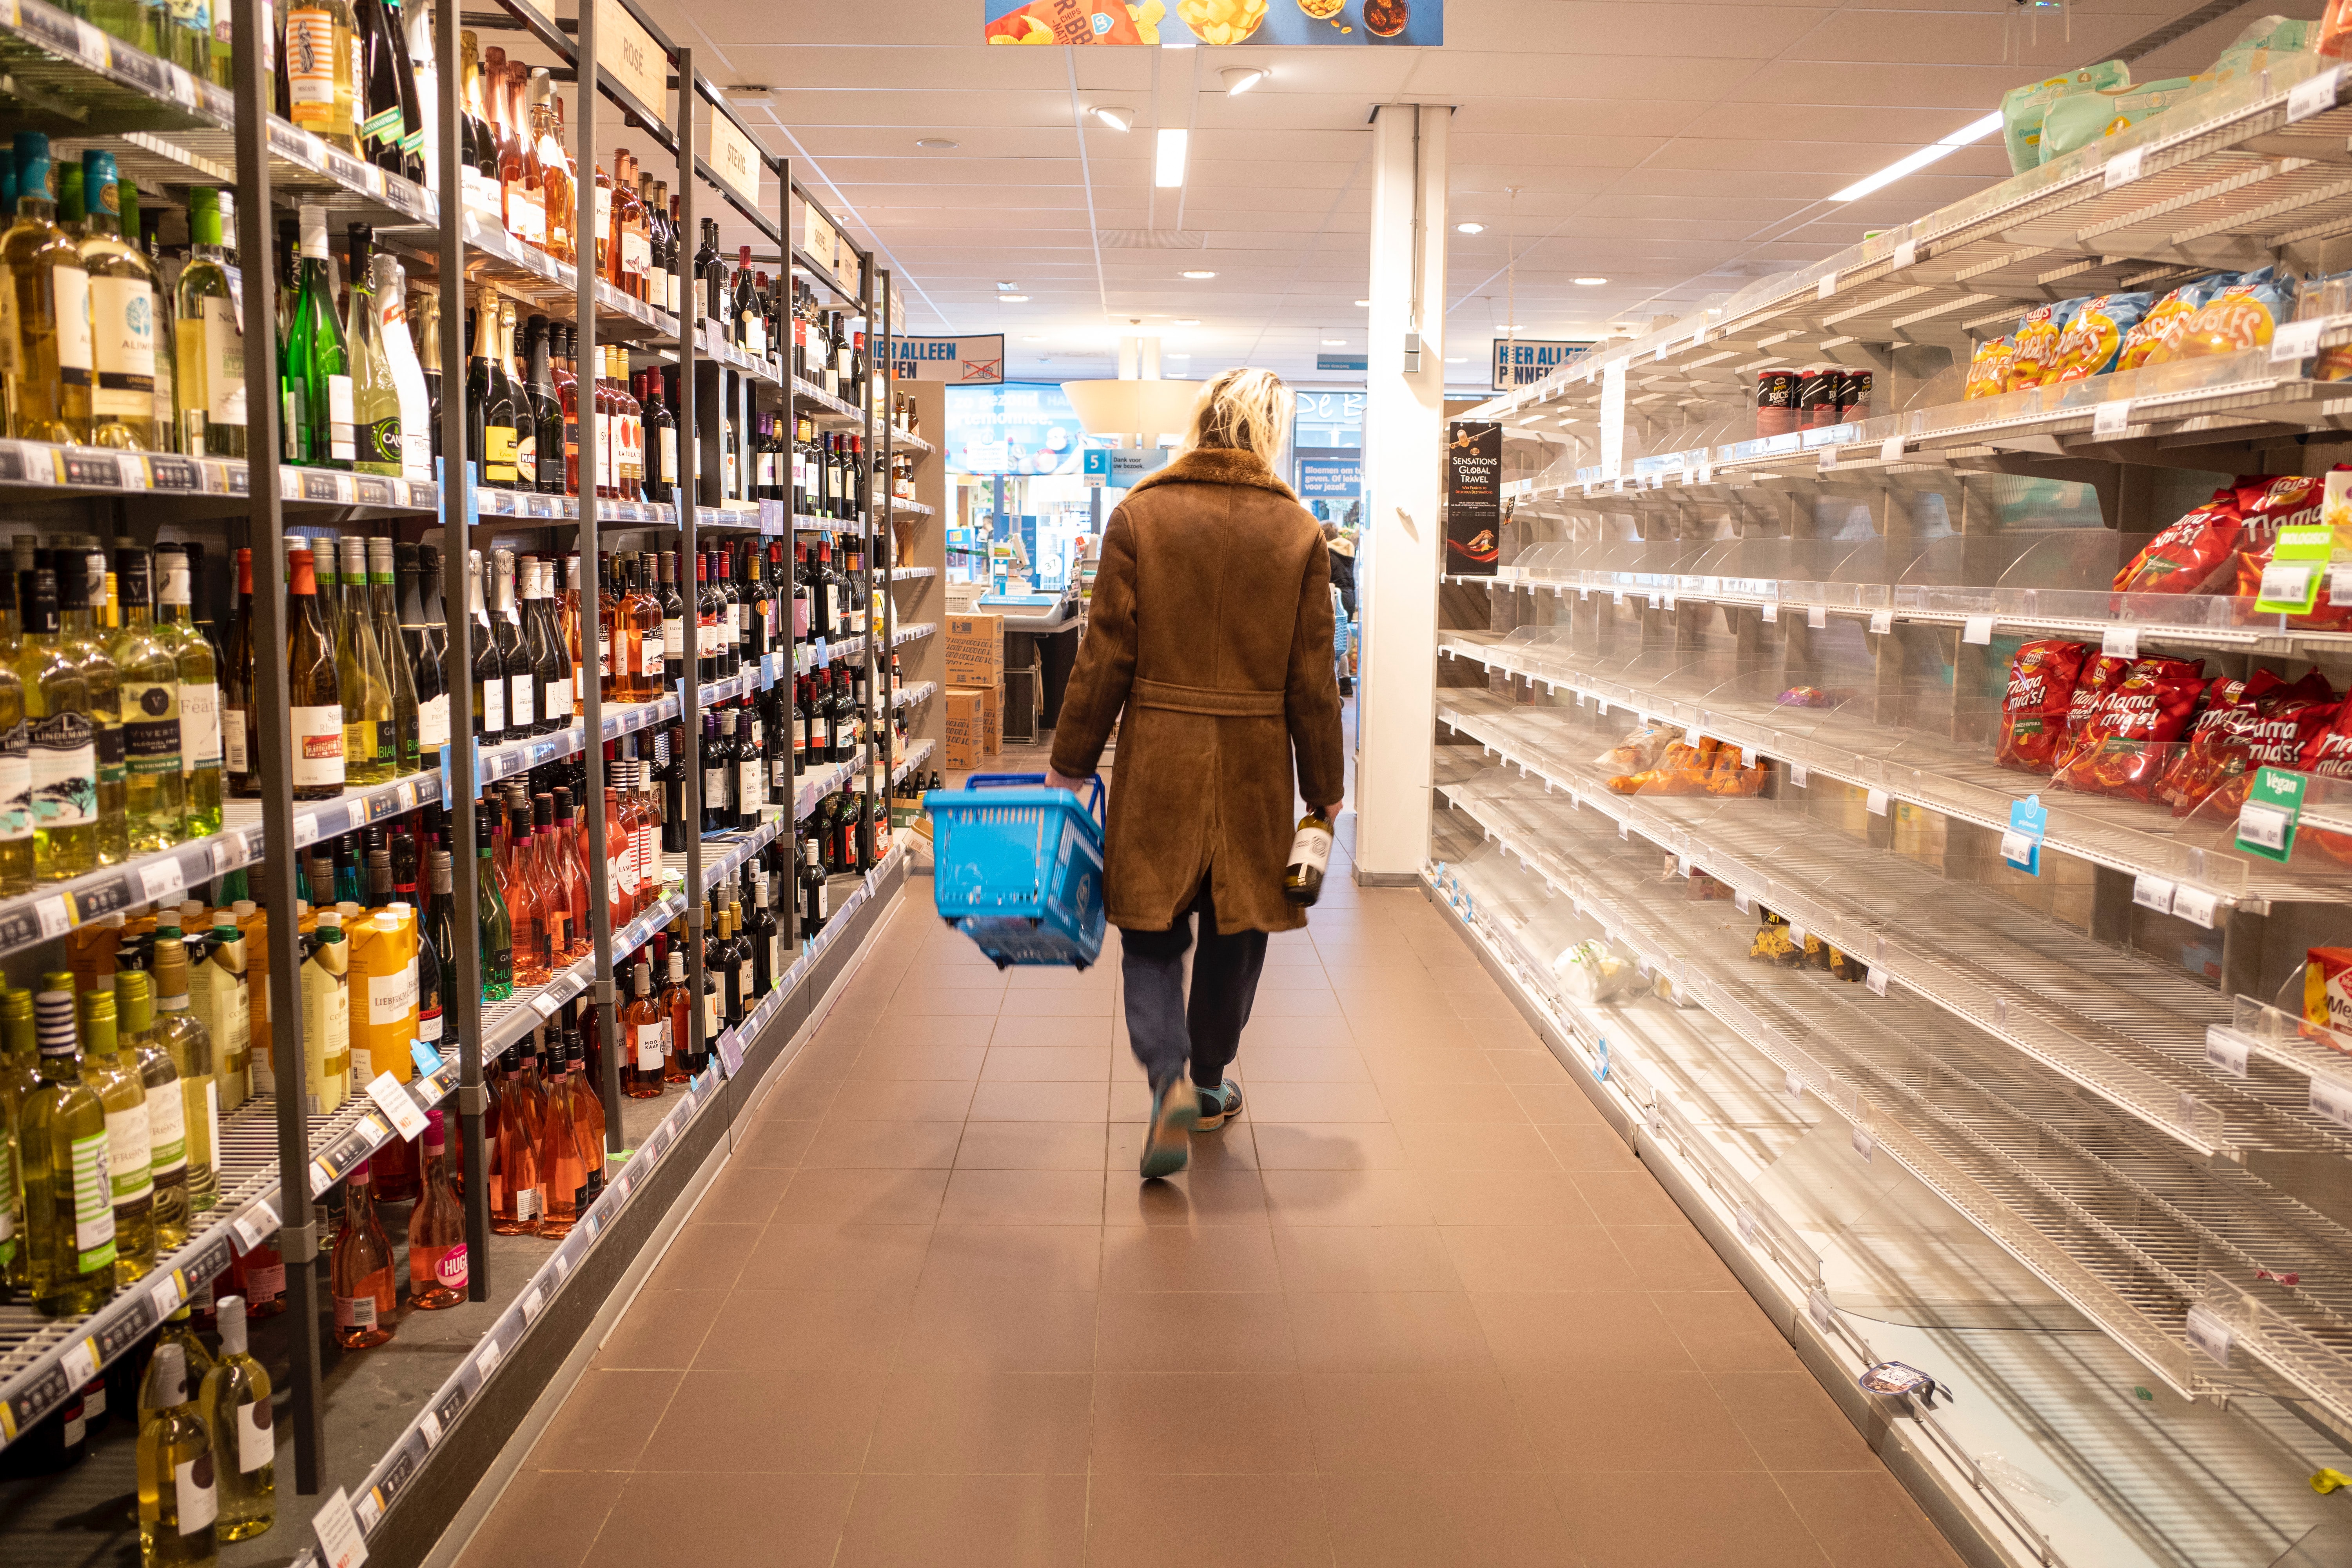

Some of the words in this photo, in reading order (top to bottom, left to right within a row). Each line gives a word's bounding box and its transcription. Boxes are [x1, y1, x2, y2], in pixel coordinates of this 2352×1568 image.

[1060, 8, 1081, 23] CHIPS
[623, 36, 644, 77] ROSÉ
[727, 142, 746, 176] STEVIG
[815, 228, 826, 252] SOEPEL
[900, 342, 956, 360] ALLEEN
[1499, 345, 1534, 365] HER
[979, 392, 1038, 410] gezond
[1090, 455, 1099, 469] 5
[1452, 457, 1497, 466] SENSATIONS
[1459, 465, 1491, 474] GLOBAL
[1323, 483, 1347, 492] jezelf.
[1460, 474, 1489, 483] TRAVEL
[2279, 532, 2331, 545] BIOLOGISCH
[1044, 559, 1057, 571] 37
[47, 612, 59, 630] L
[2022, 651, 2044, 666] Lay's
[2006, 674, 2043, 694] Mama
[2007, 686, 2046, 711] mia's!
[2266, 771, 2298, 794] Vegan
